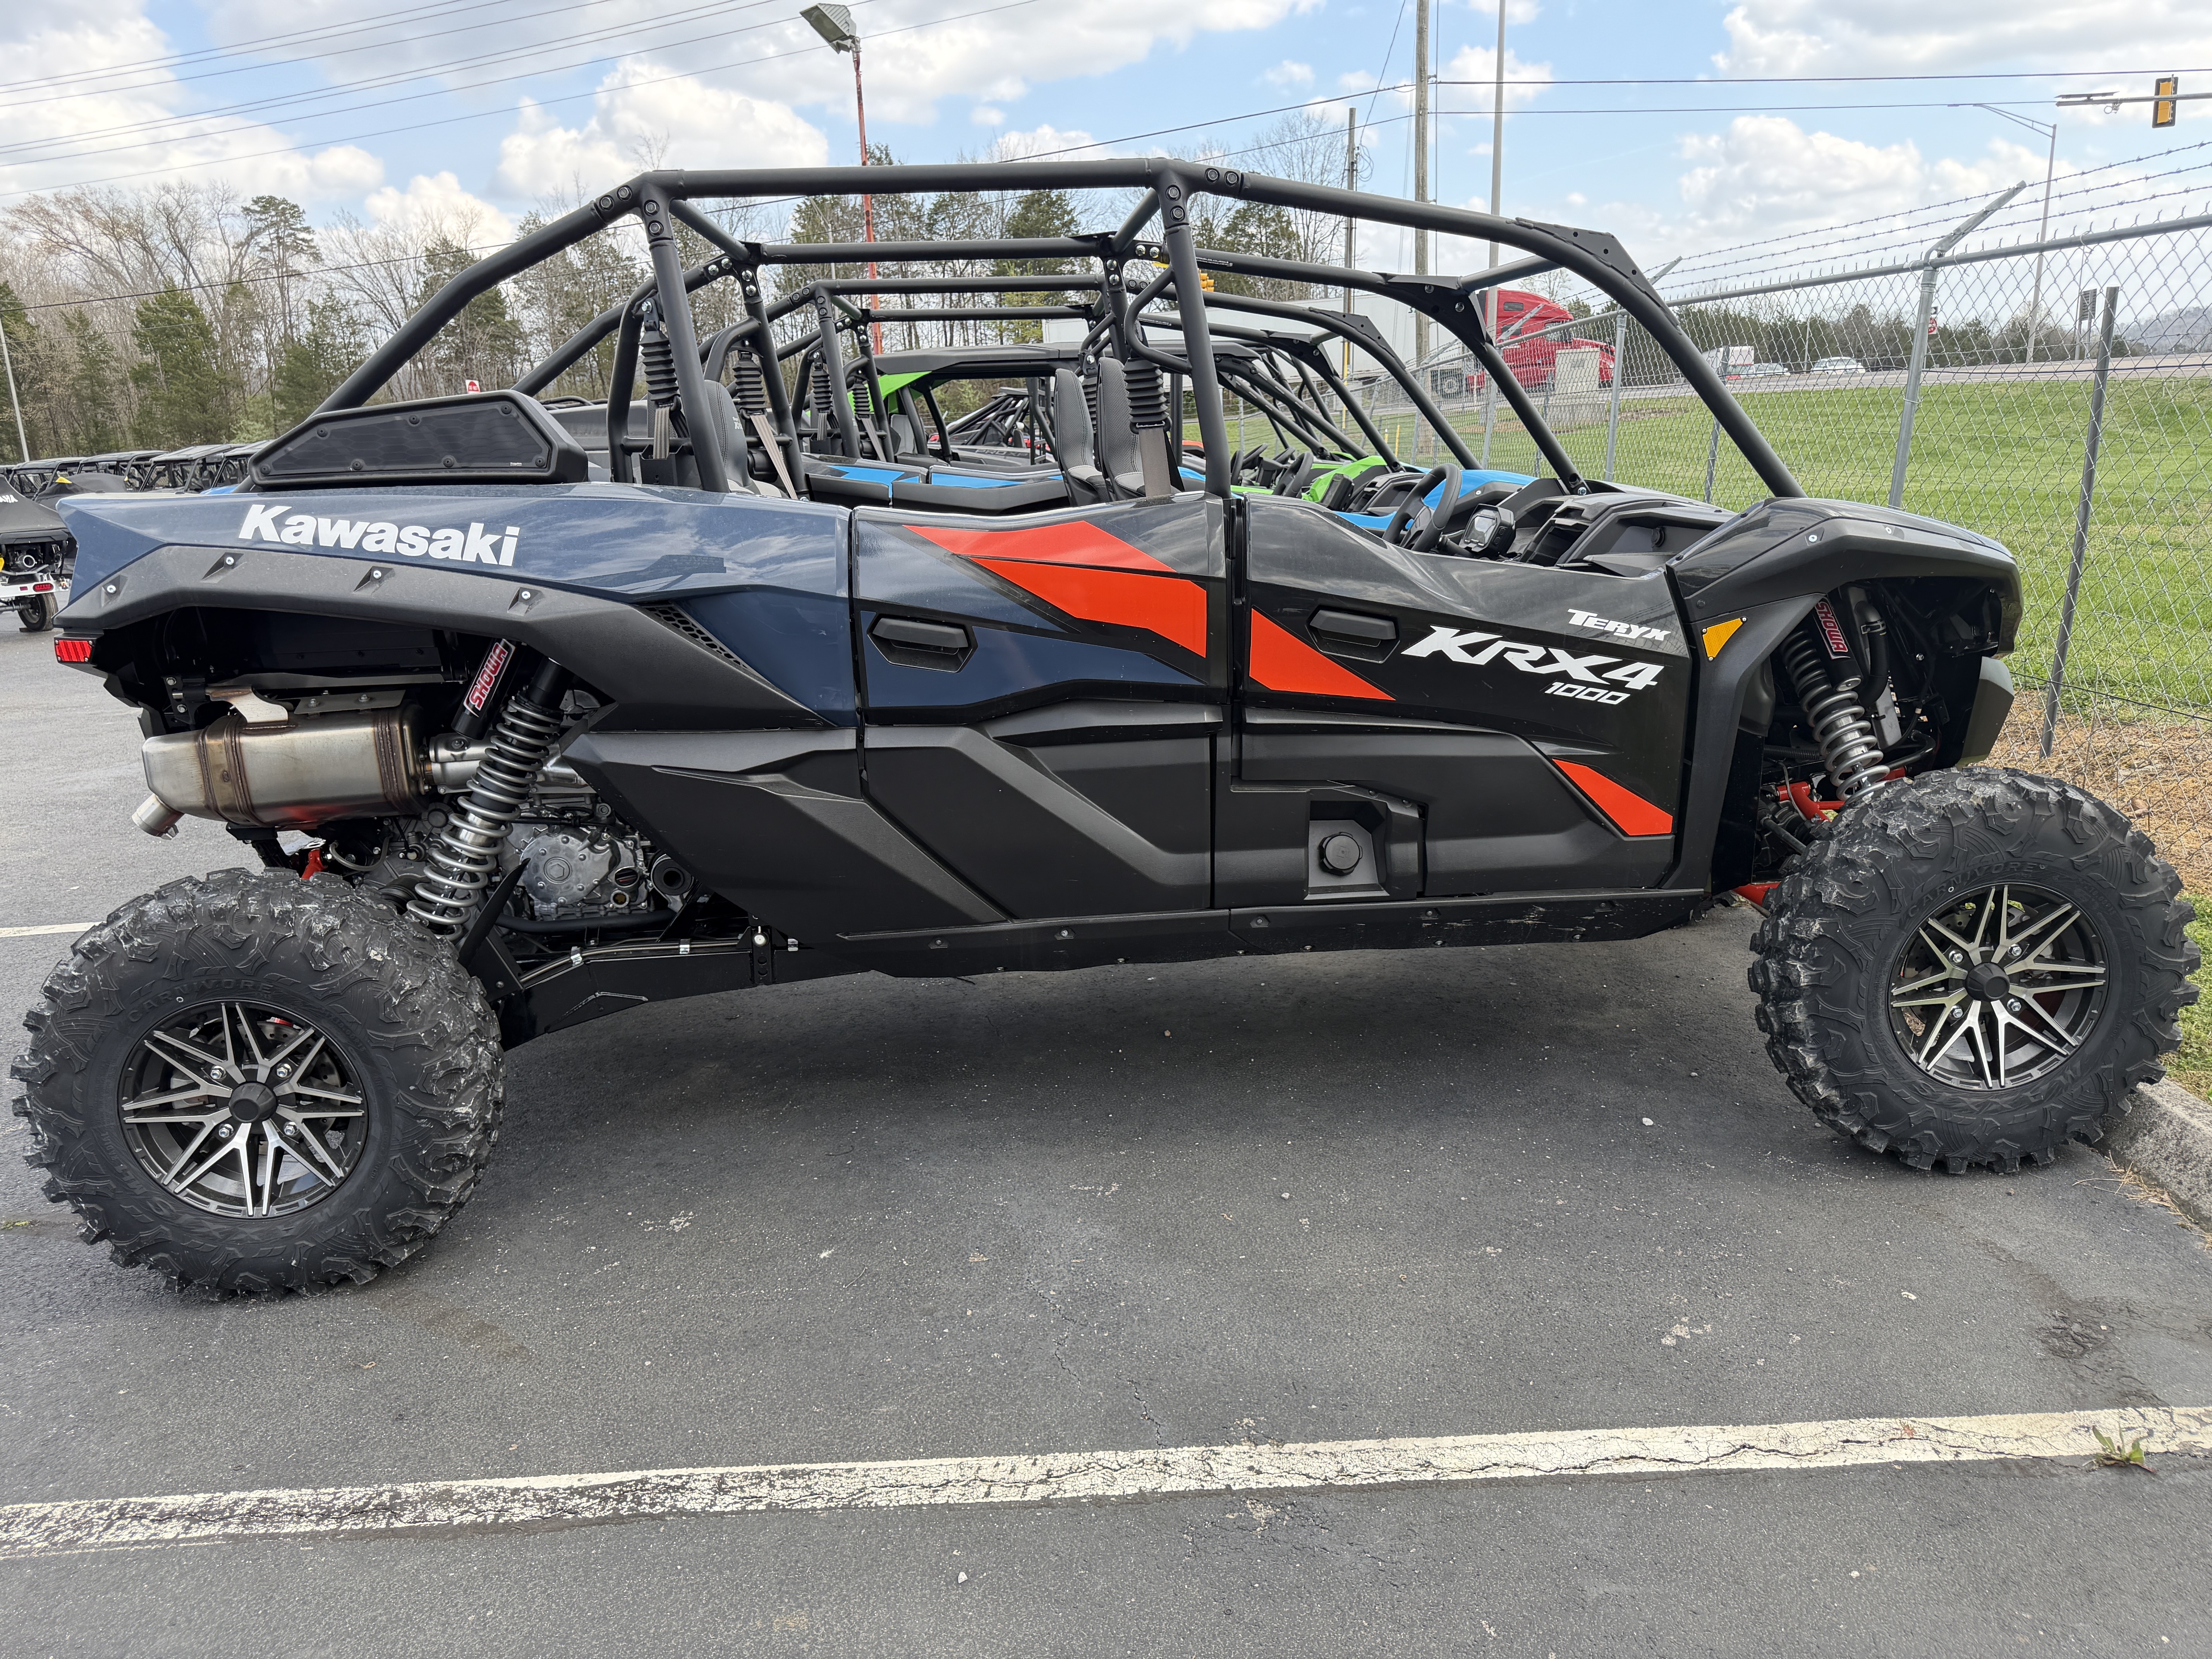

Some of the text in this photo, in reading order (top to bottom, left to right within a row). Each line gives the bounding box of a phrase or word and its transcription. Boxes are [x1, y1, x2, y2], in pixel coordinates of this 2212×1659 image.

[239, 504, 520, 567] Kawasaki
[1814, 601, 1848, 653] SHOWA
[469, 642, 508, 711] SHOWA
[1401, 625, 1665, 690] KRX4
[1544, 682, 1631, 705] 1000
[1908, 862, 2037, 917] CARNIVORE
[127, 979, 273, 1022] CARNIVORE
